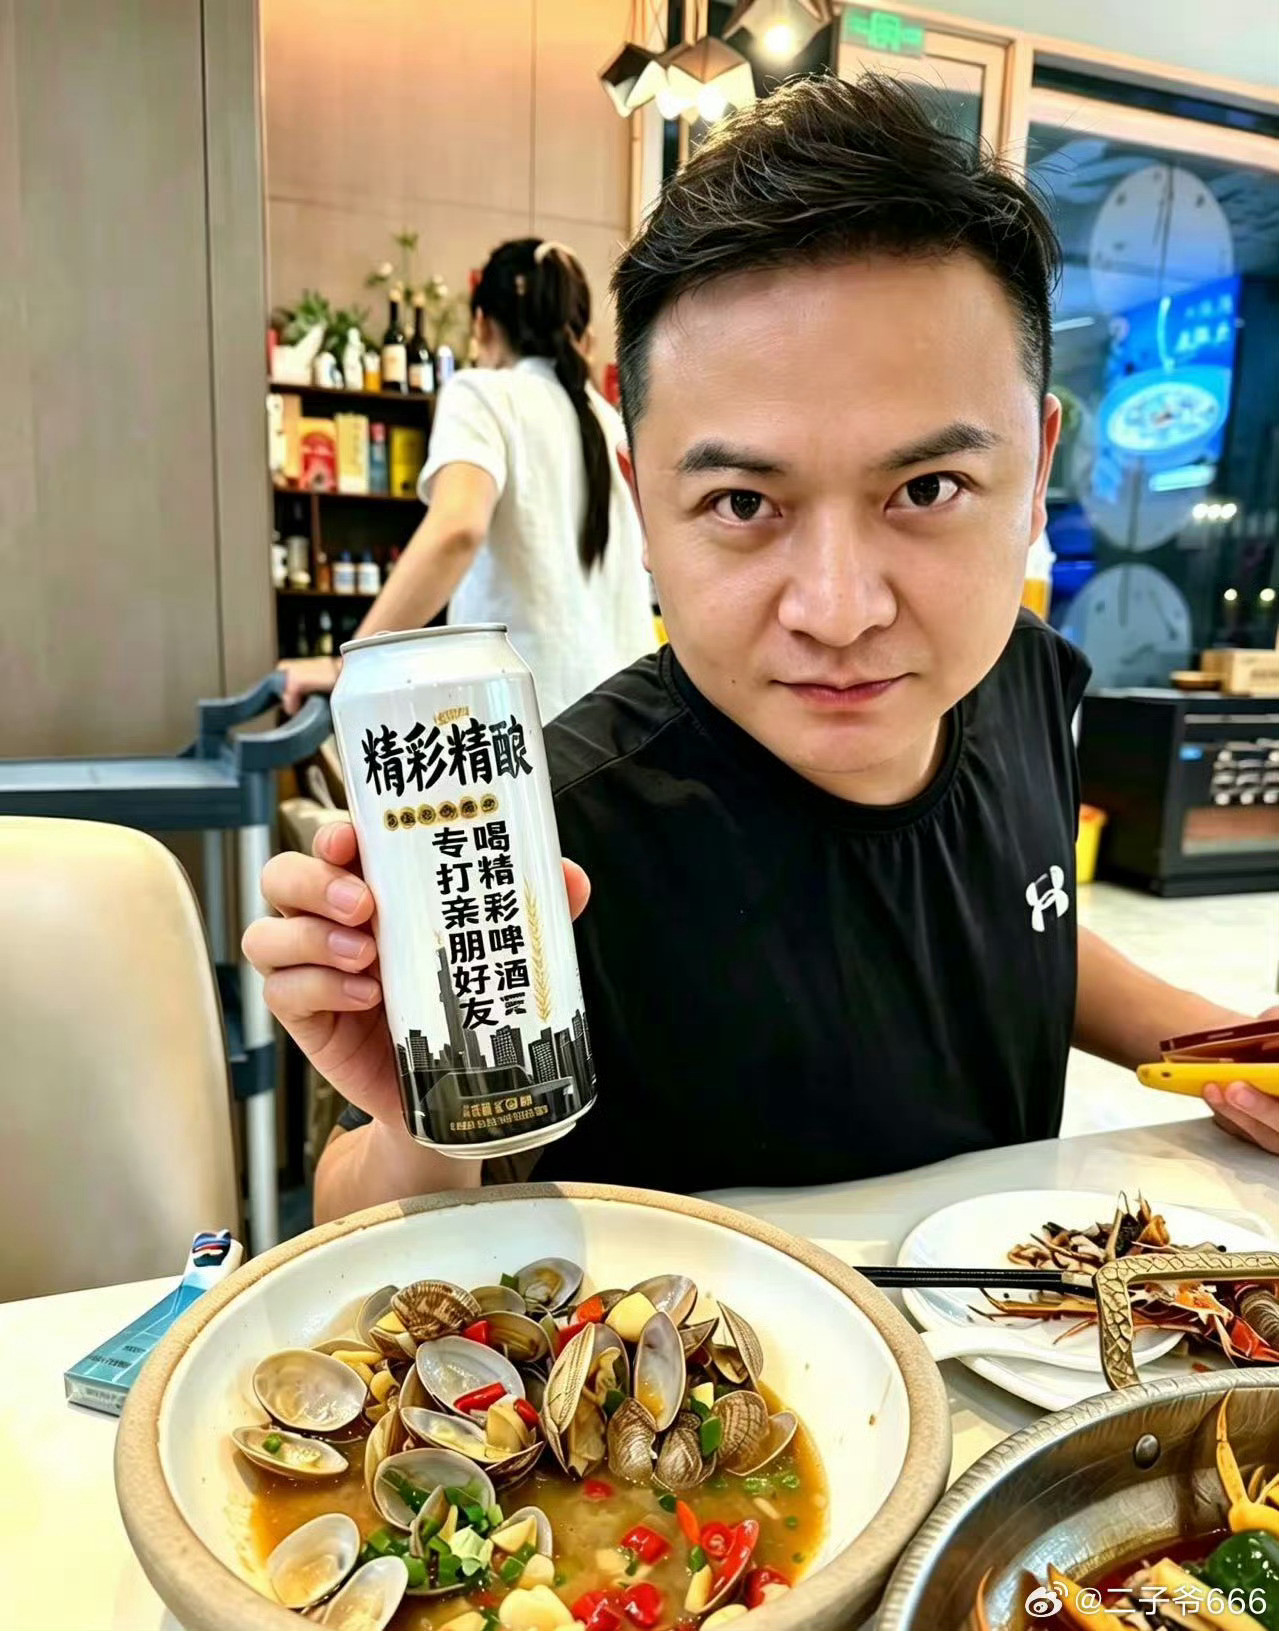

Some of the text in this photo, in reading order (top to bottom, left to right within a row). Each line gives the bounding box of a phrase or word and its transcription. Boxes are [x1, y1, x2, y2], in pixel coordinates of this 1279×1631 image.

[361, 714, 533, 797] 精彩精酿
[432, 827, 499, 1030] 专打亲朋好友
